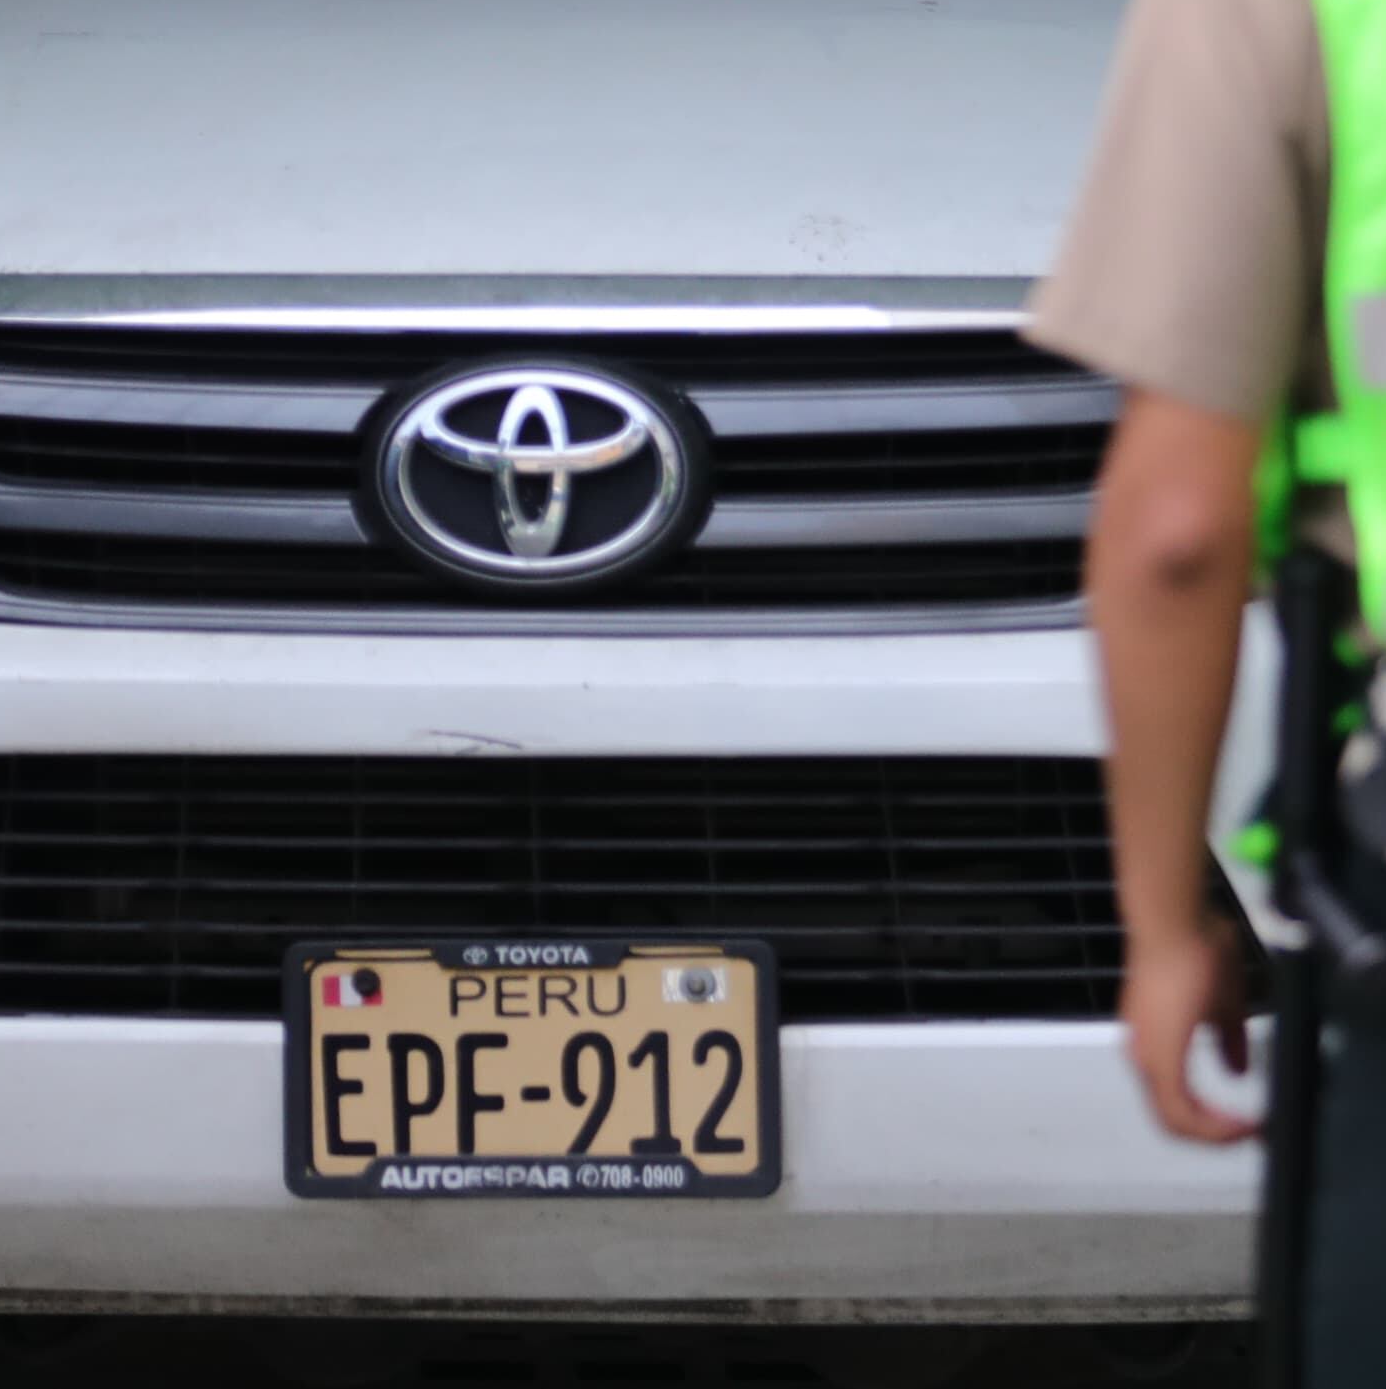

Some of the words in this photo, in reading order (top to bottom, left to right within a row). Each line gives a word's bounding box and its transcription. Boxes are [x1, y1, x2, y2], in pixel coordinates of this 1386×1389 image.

[495, 946, 589, 965] TOYOTA
[450, 974, 626, 1017] PERU
[321, 1030, 745, 1157] EPF-912
[380, 1164, 569, 1189] AUTOESPAR
